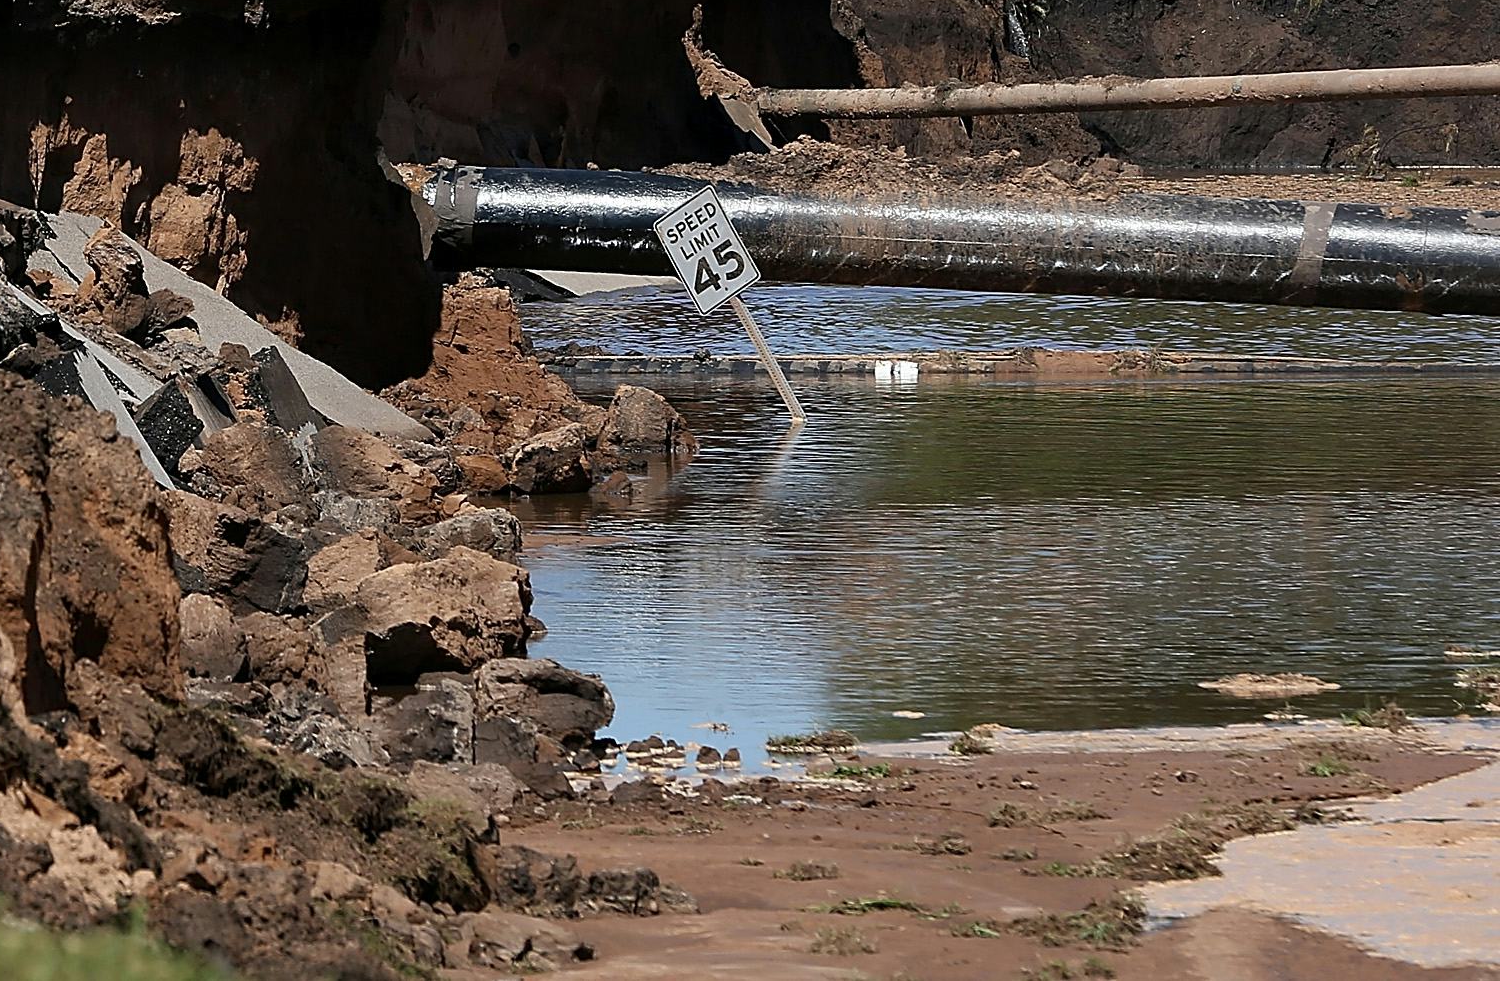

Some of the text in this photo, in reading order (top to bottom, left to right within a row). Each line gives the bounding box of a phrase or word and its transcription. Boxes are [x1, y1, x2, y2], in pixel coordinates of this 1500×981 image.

[666, 202, 717, 244] SPEED
[680, 223, 721, 260] LIMIT
[694, 239, 745, 295] 45
